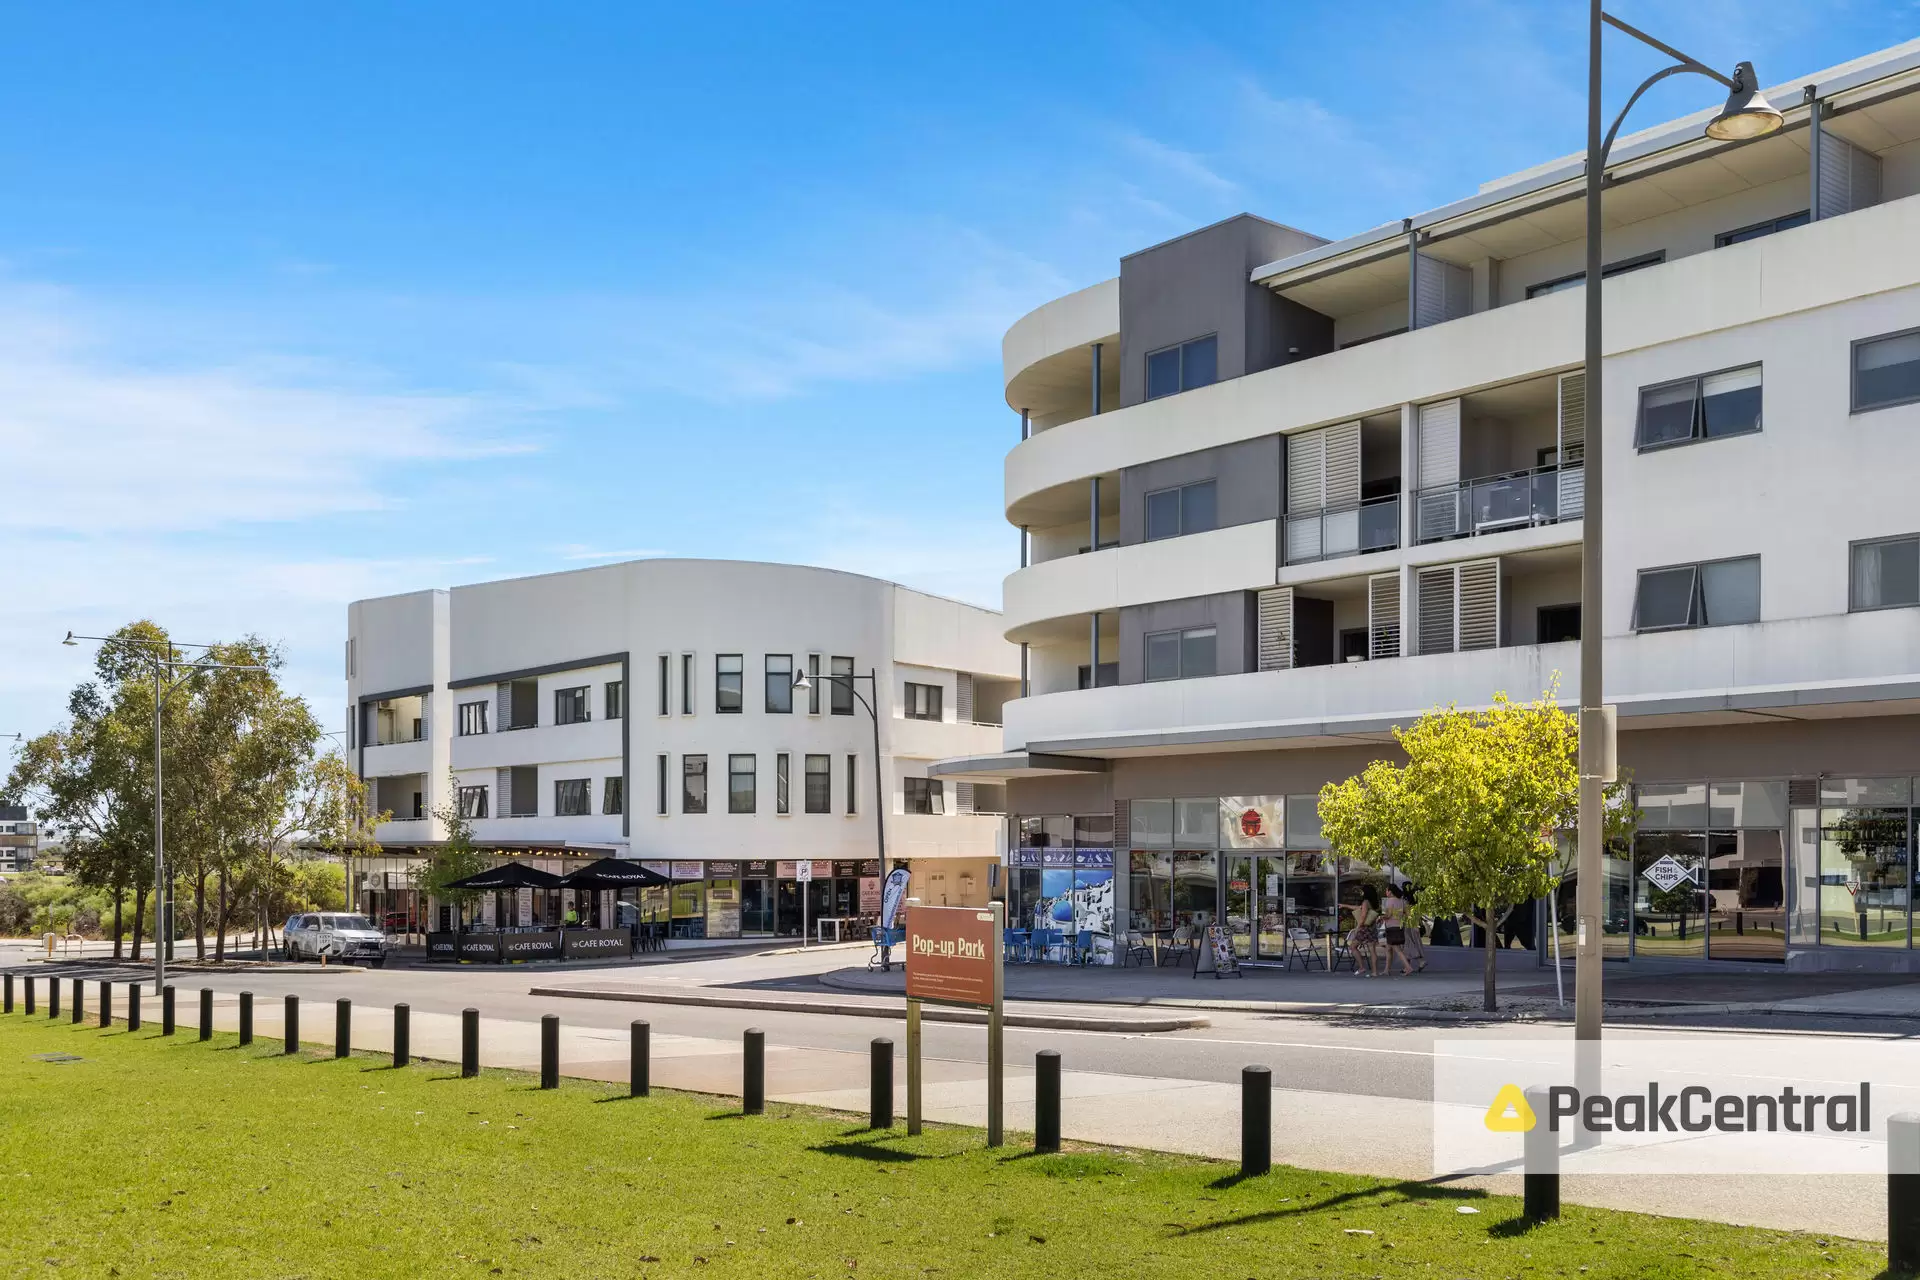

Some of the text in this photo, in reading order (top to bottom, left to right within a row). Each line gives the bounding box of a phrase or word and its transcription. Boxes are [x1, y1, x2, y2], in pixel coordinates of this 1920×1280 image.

[466, 943, 495, 951] CAFE ROYAL
[514, 942, 554, 951] CAFE ROYAL
[578, 938, 624, 948] CAFE ROYAL
[913, 934, 985, 959] Pop-up Park
